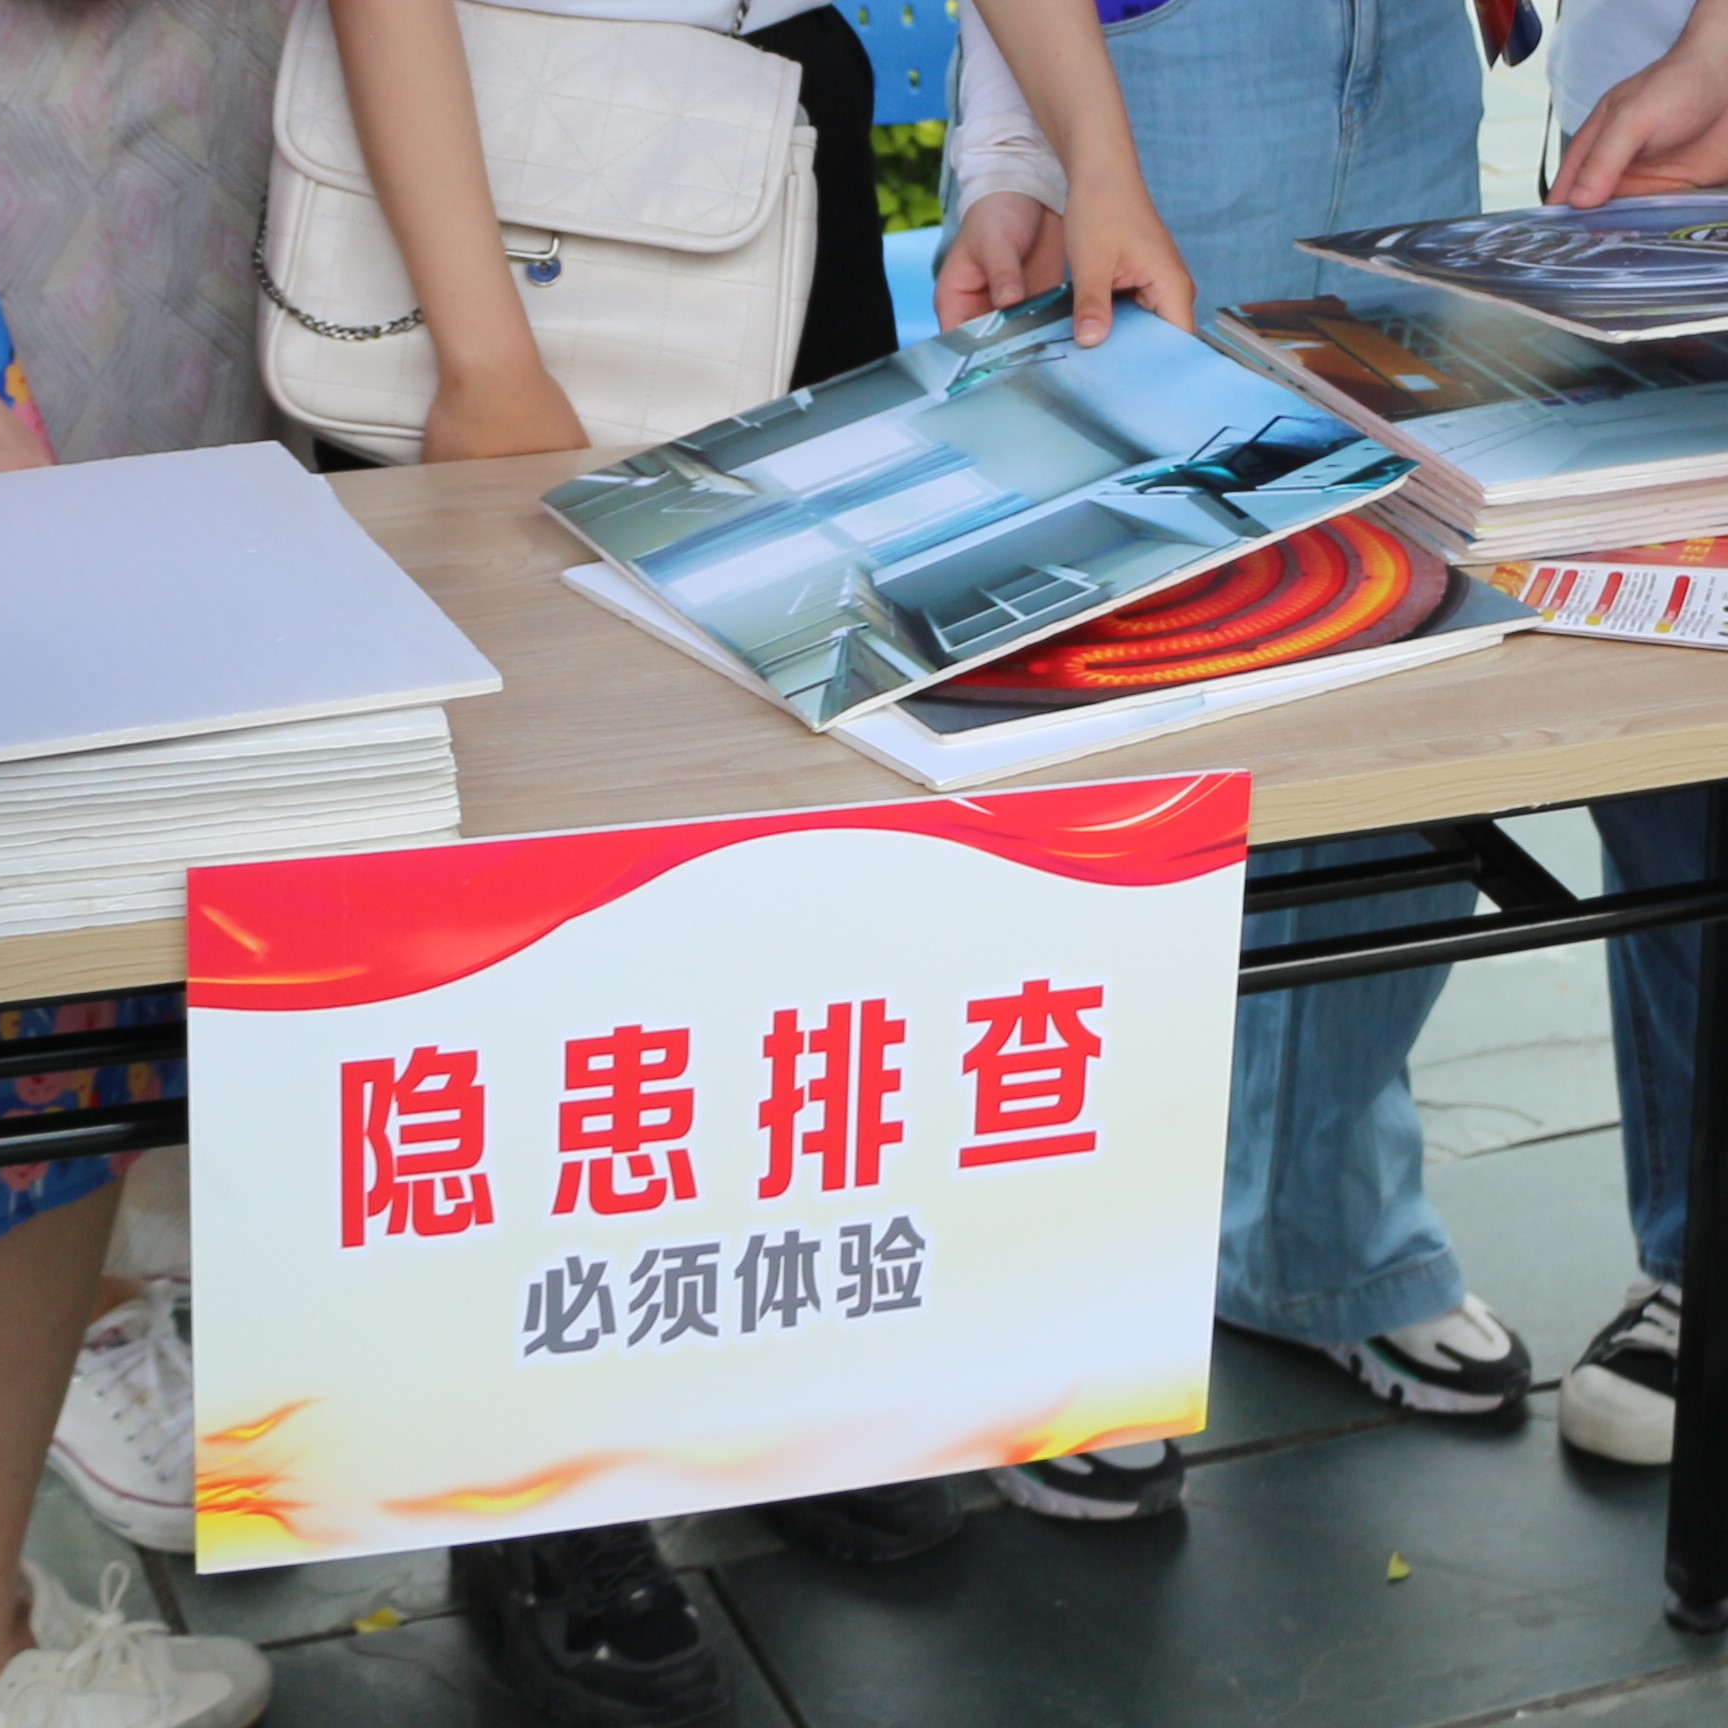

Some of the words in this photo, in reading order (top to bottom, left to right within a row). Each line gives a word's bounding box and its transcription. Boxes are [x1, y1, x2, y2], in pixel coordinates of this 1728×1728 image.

[338, 976, 1106, 1249] 隐患排查
[521, 1214, 927, 1360] 必须体验
